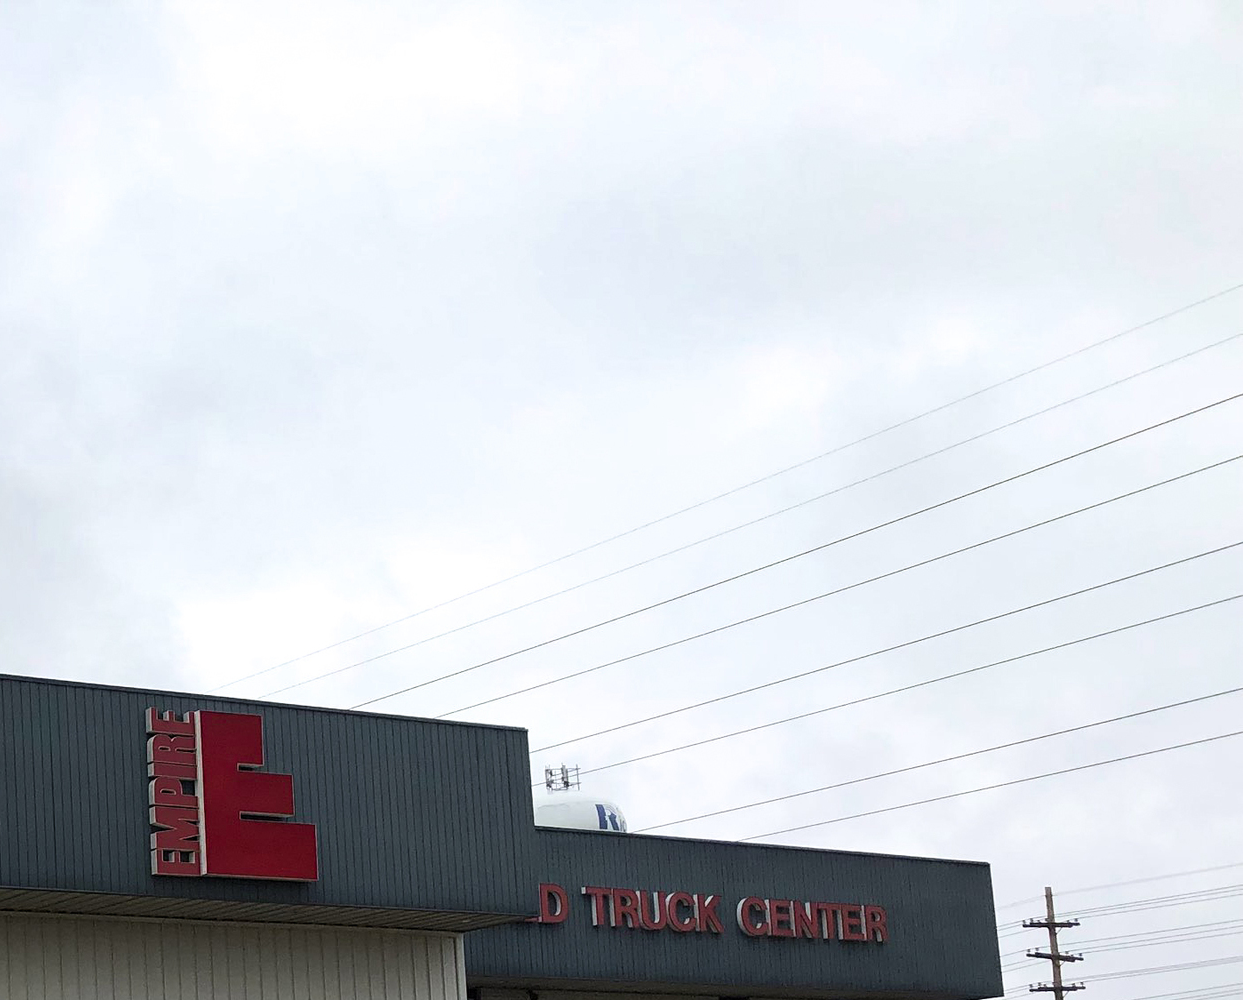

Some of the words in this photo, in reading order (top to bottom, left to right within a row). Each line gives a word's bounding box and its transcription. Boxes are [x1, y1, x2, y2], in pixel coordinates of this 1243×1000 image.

[146, 707, 200, 876] EMPIRE
[526, 882, 569, 923] D
[581, 886, 724, 934] TRUCK
[736, 896, 890, 943] CENTER
